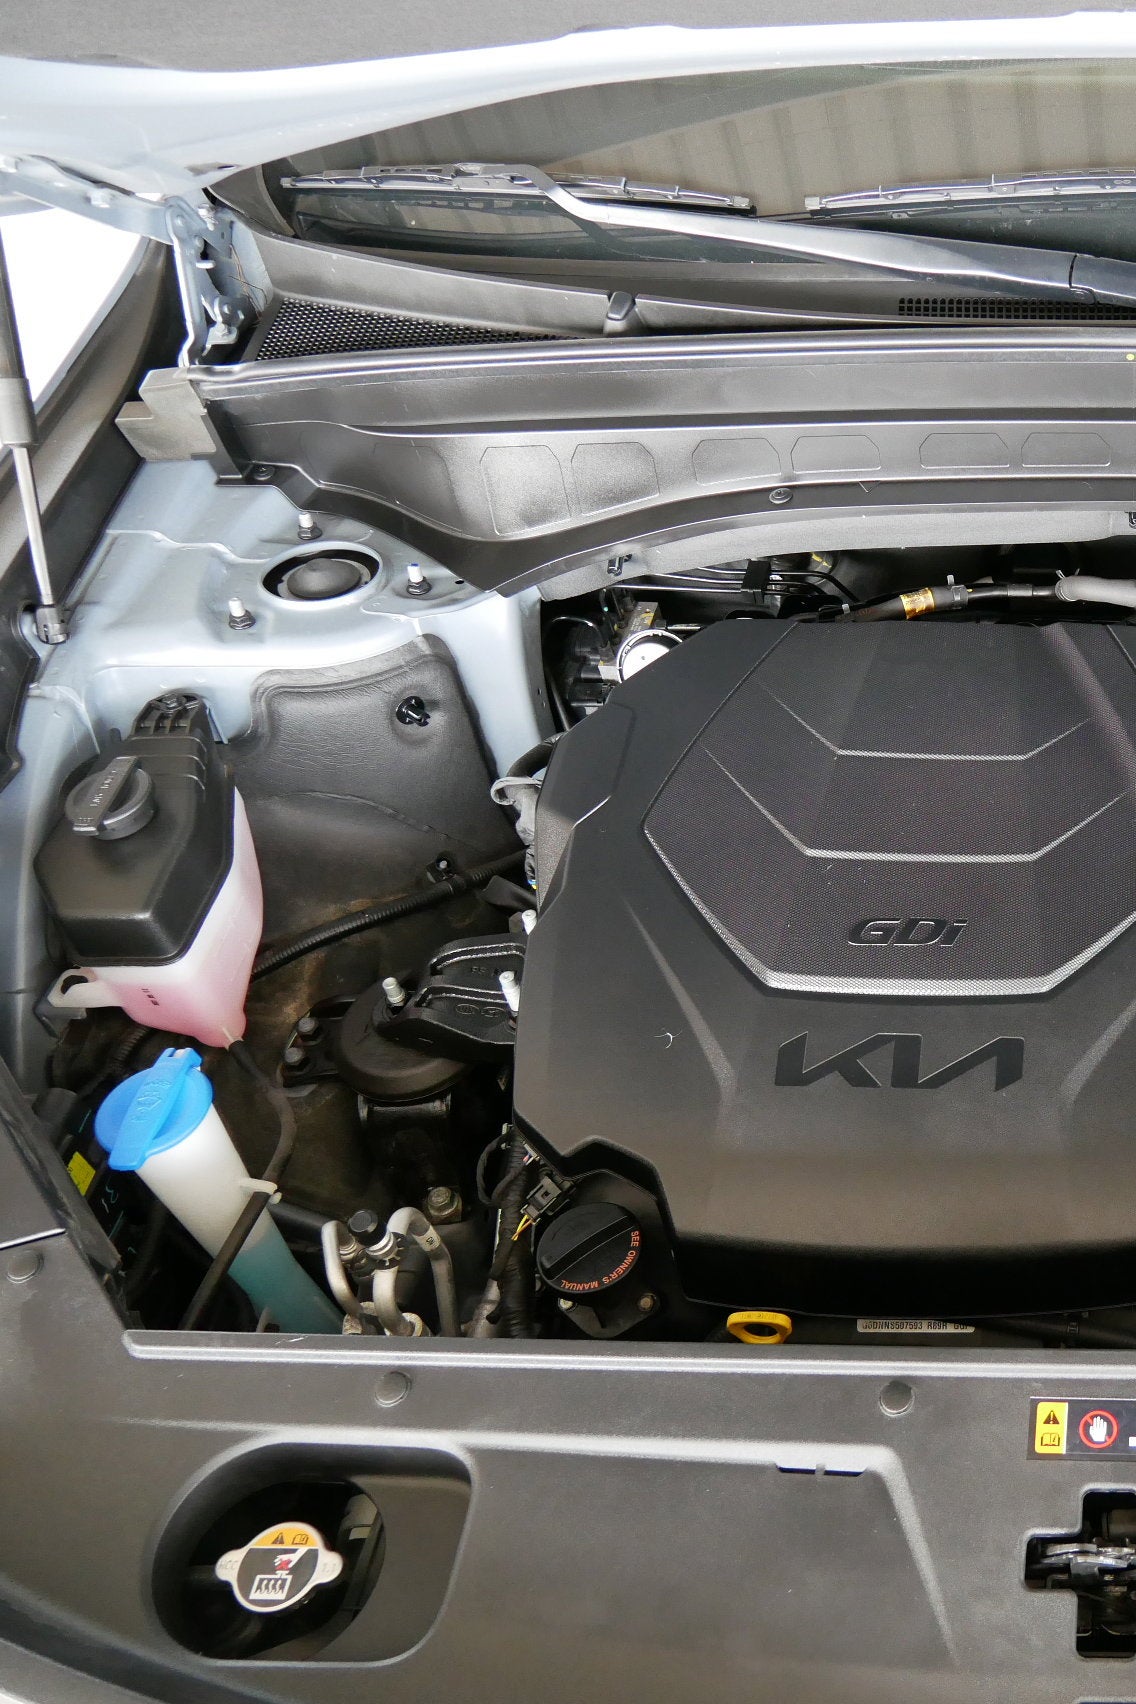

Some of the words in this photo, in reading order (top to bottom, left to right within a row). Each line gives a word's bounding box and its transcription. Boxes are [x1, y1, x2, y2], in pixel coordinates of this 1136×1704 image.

[847, 917, 968, 947] GDi
[774, 1030, 1025, 1092] KIA
[630, 1230, 640, 1247] SEE
[602, 1250, 636, 1284] OWNER'S
[560, 1279, 600, 1291] MANUAL
